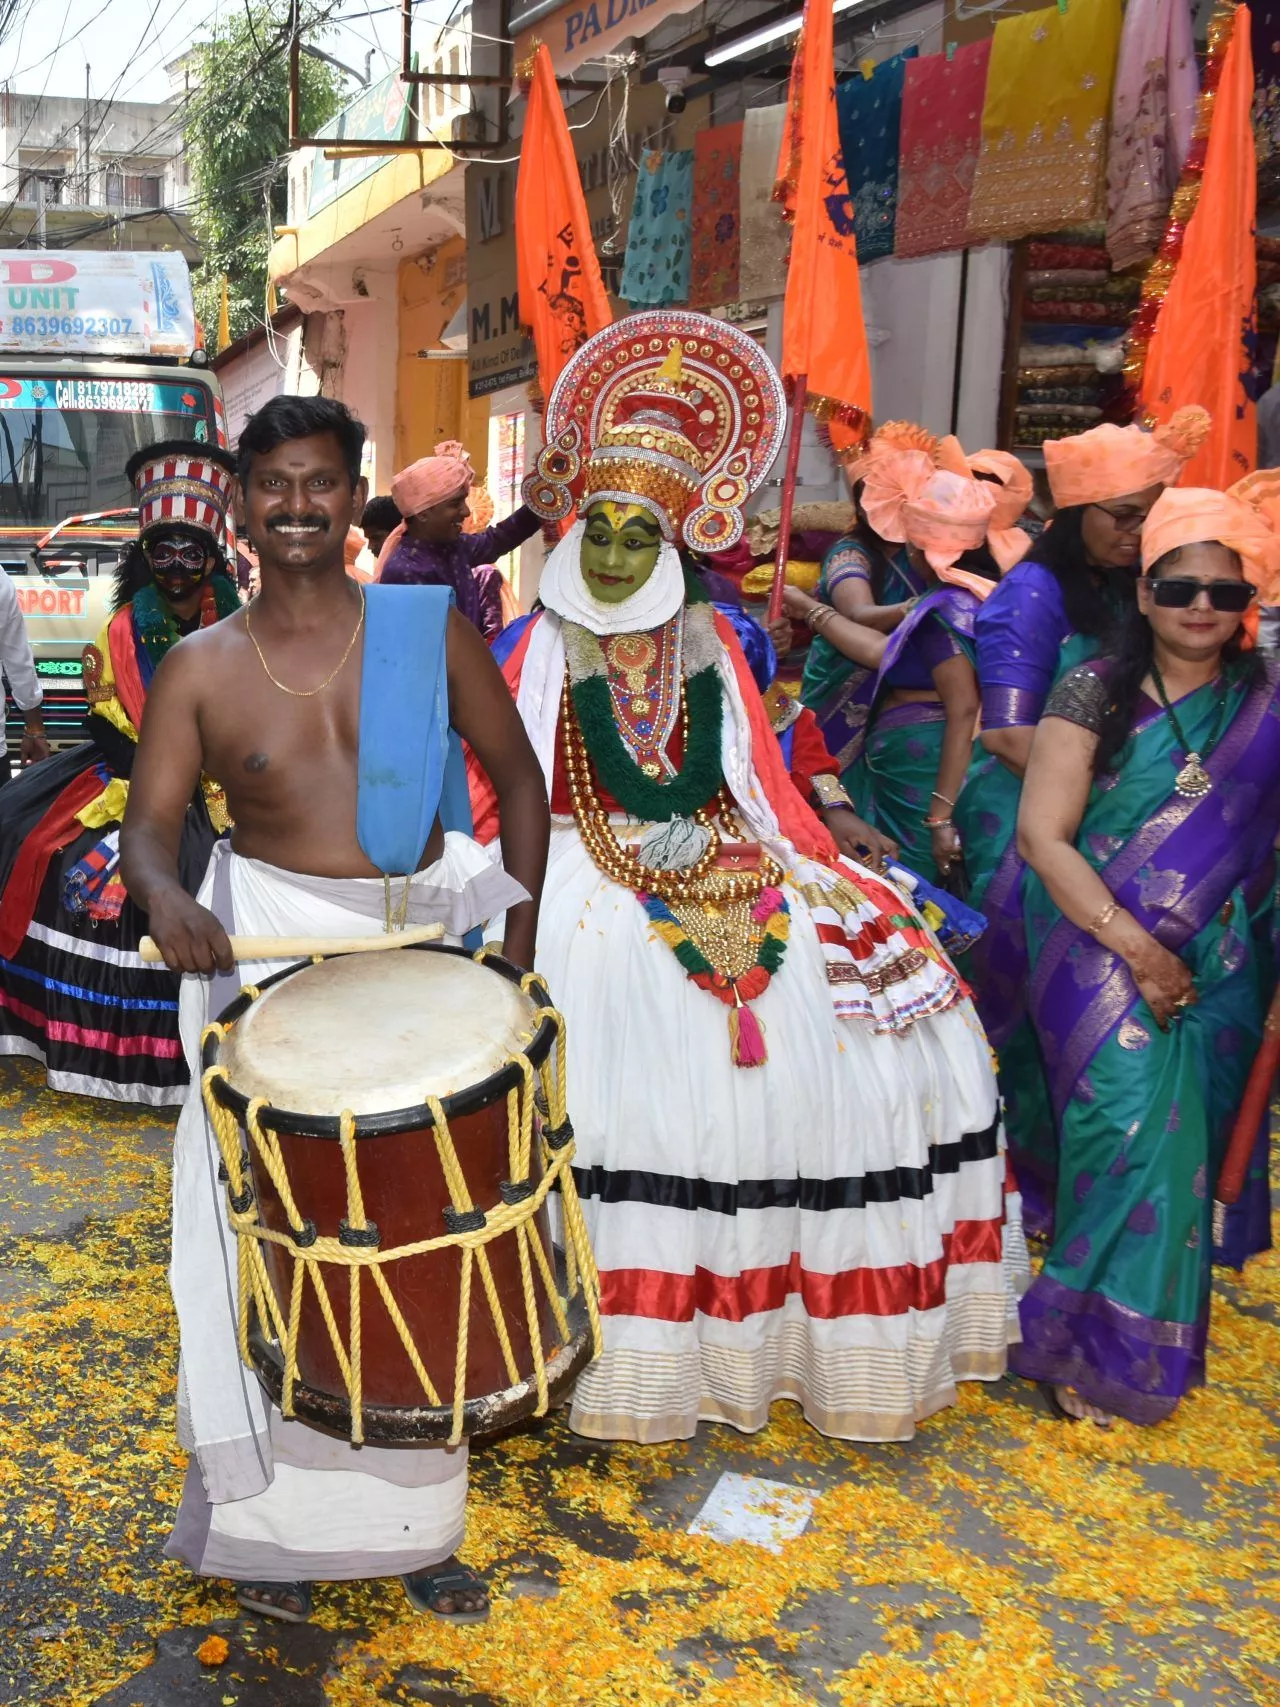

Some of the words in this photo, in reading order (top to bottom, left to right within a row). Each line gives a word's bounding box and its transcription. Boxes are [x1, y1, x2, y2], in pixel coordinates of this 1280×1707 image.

[1, 259, 78, 284] D
[8, 287, 80, 311] UNIT
[11, 316, 133, 336] 8639692307
[16, 588, 85, 615] SPORT
